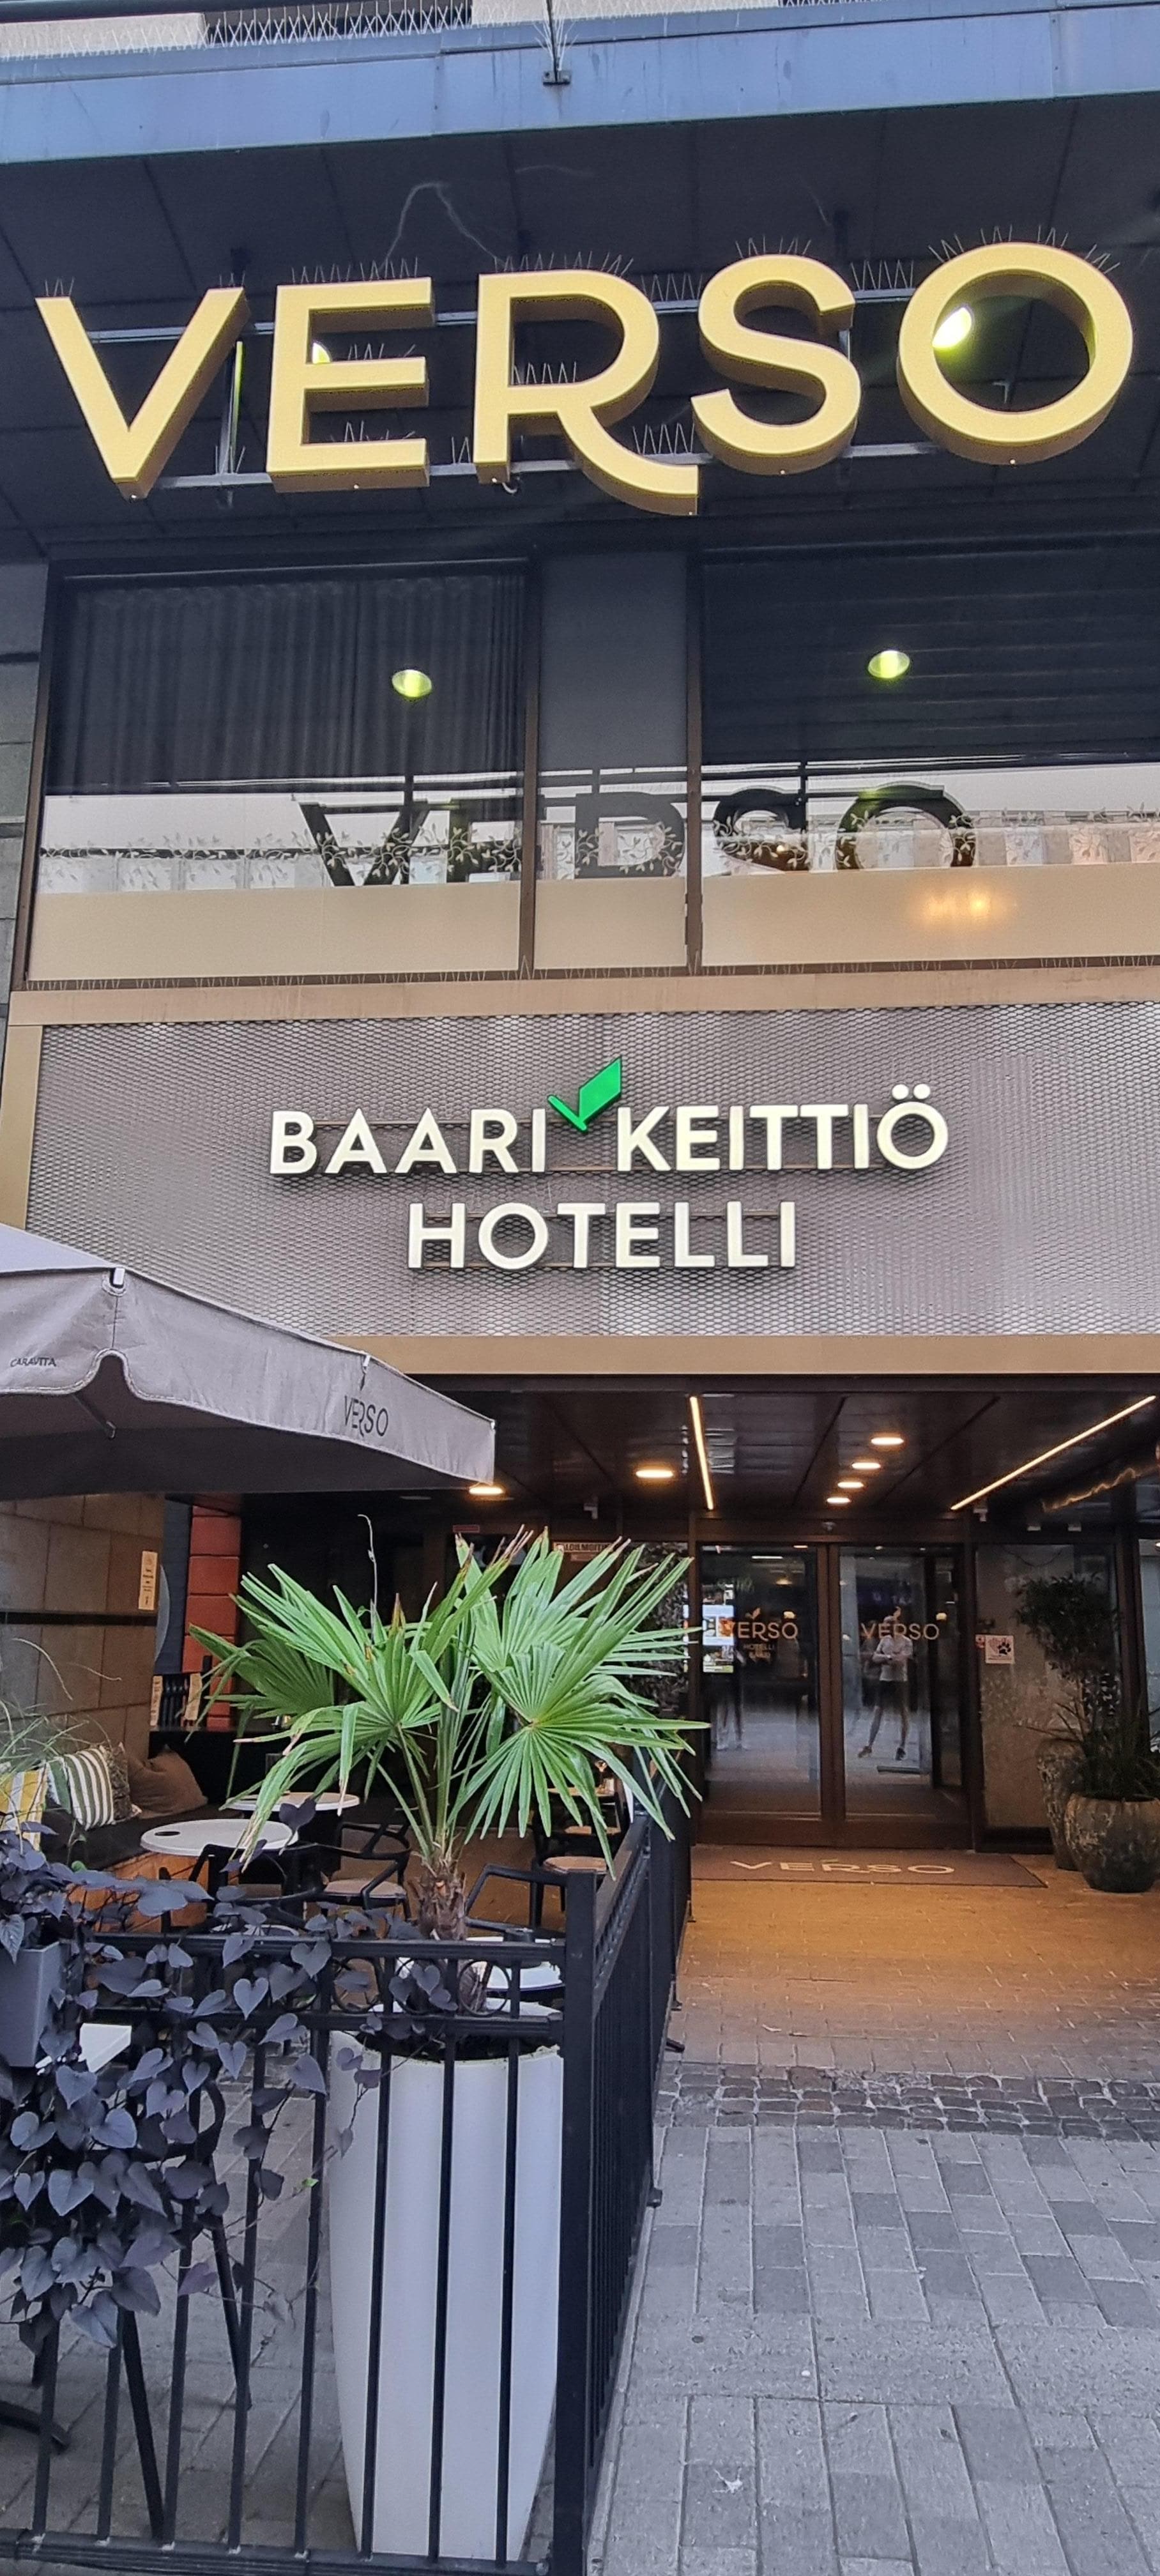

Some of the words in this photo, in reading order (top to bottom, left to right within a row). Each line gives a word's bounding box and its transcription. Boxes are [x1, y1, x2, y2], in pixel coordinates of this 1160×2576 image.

[35, 241, 1134, 513] VERSO
[270, 1107, 547, 1174] BAARI
[616, 1083, 949, 1172] KEITTIÖ
[408, 1200, 795, 1269] HOTELLI
[10, 1357, 57, 1368] CARAVITA
[344, 1395, 389, 1438] VERSO
[860, 1622, 940, 1641] VERSO
[729, 1860, 955, 1874] VERSO
